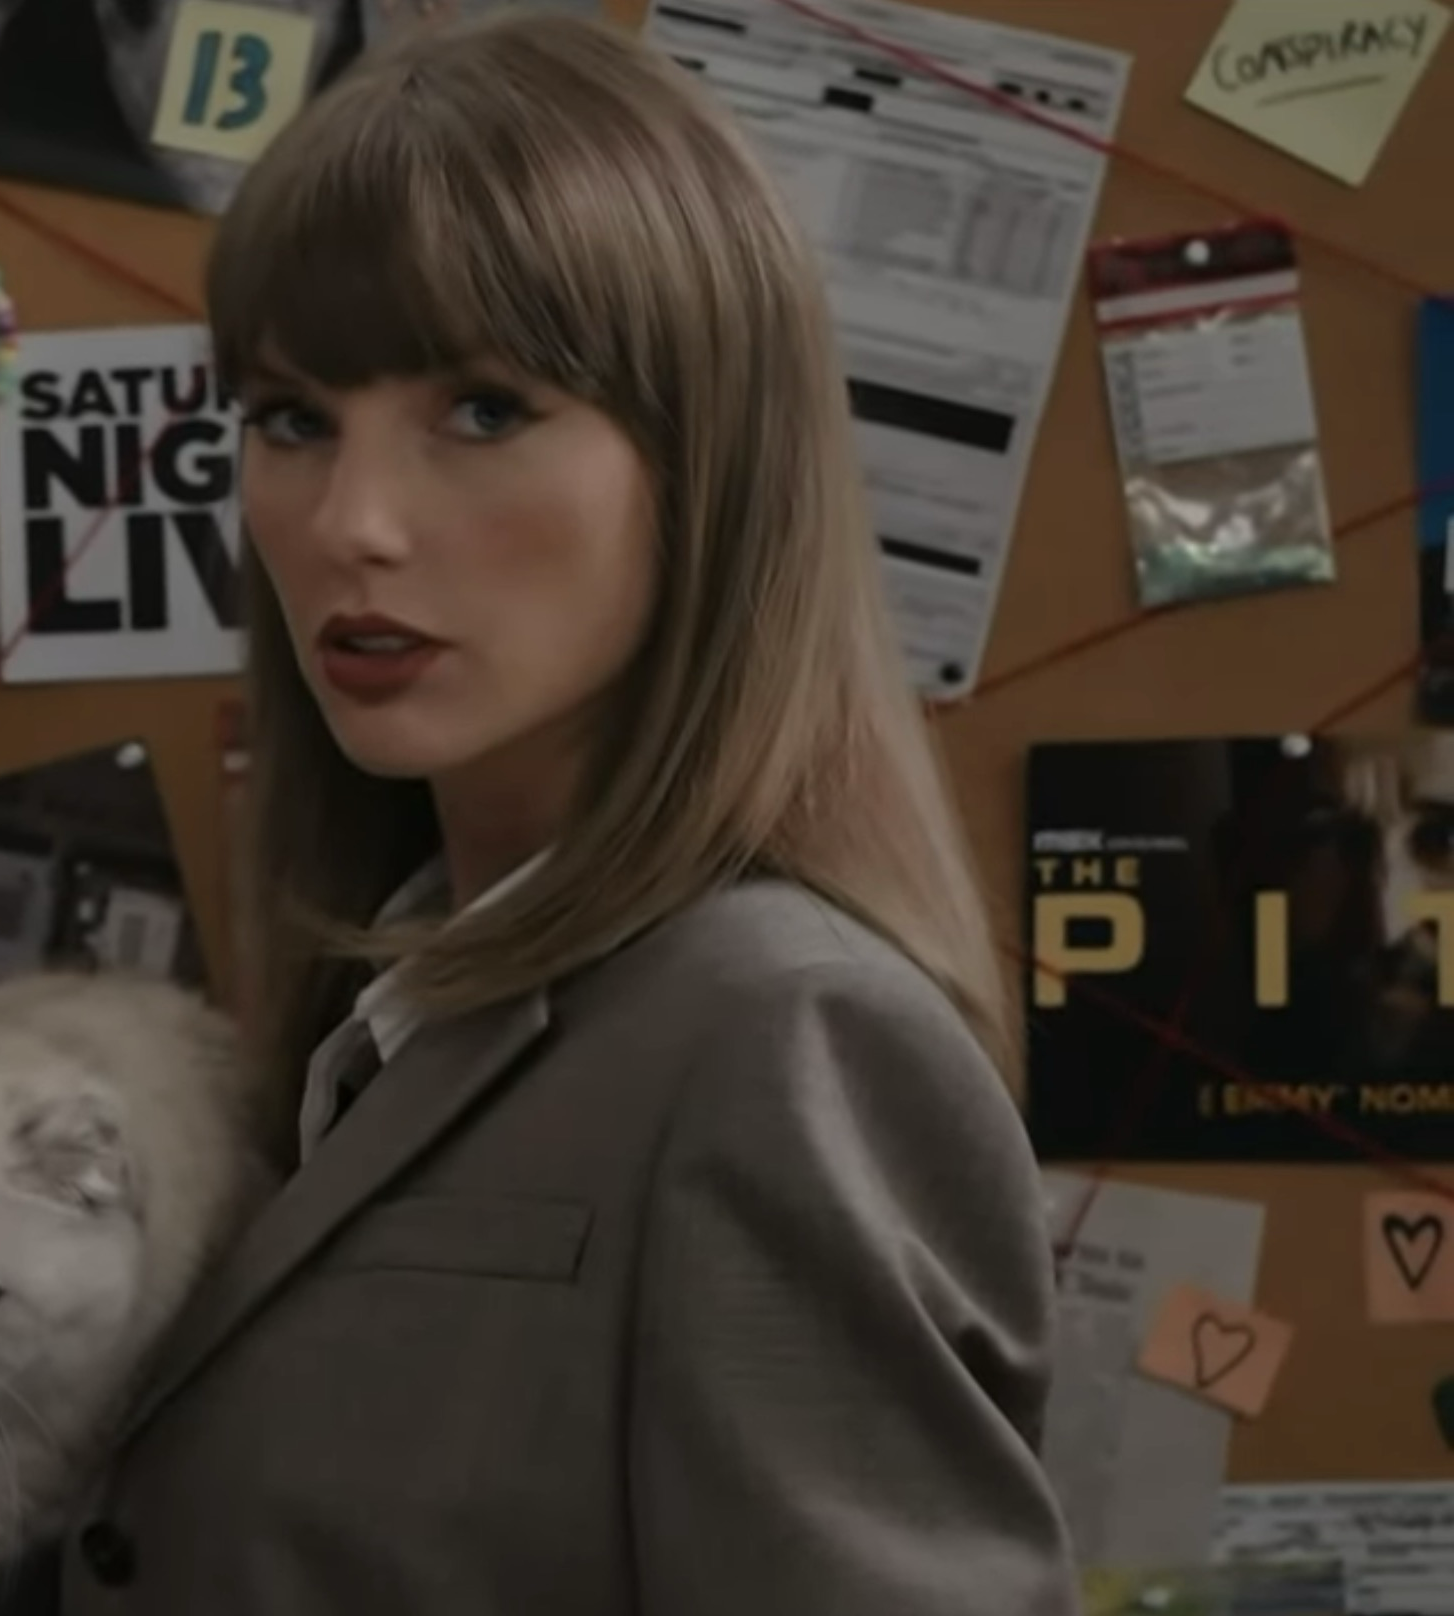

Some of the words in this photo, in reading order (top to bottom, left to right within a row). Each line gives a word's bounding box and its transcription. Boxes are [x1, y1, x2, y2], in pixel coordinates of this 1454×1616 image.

[182, 30, 271, 130] 13
[1212, 12, 1427, 91] CONSPIRACY
[1034, 856, 1141, 887] THE
